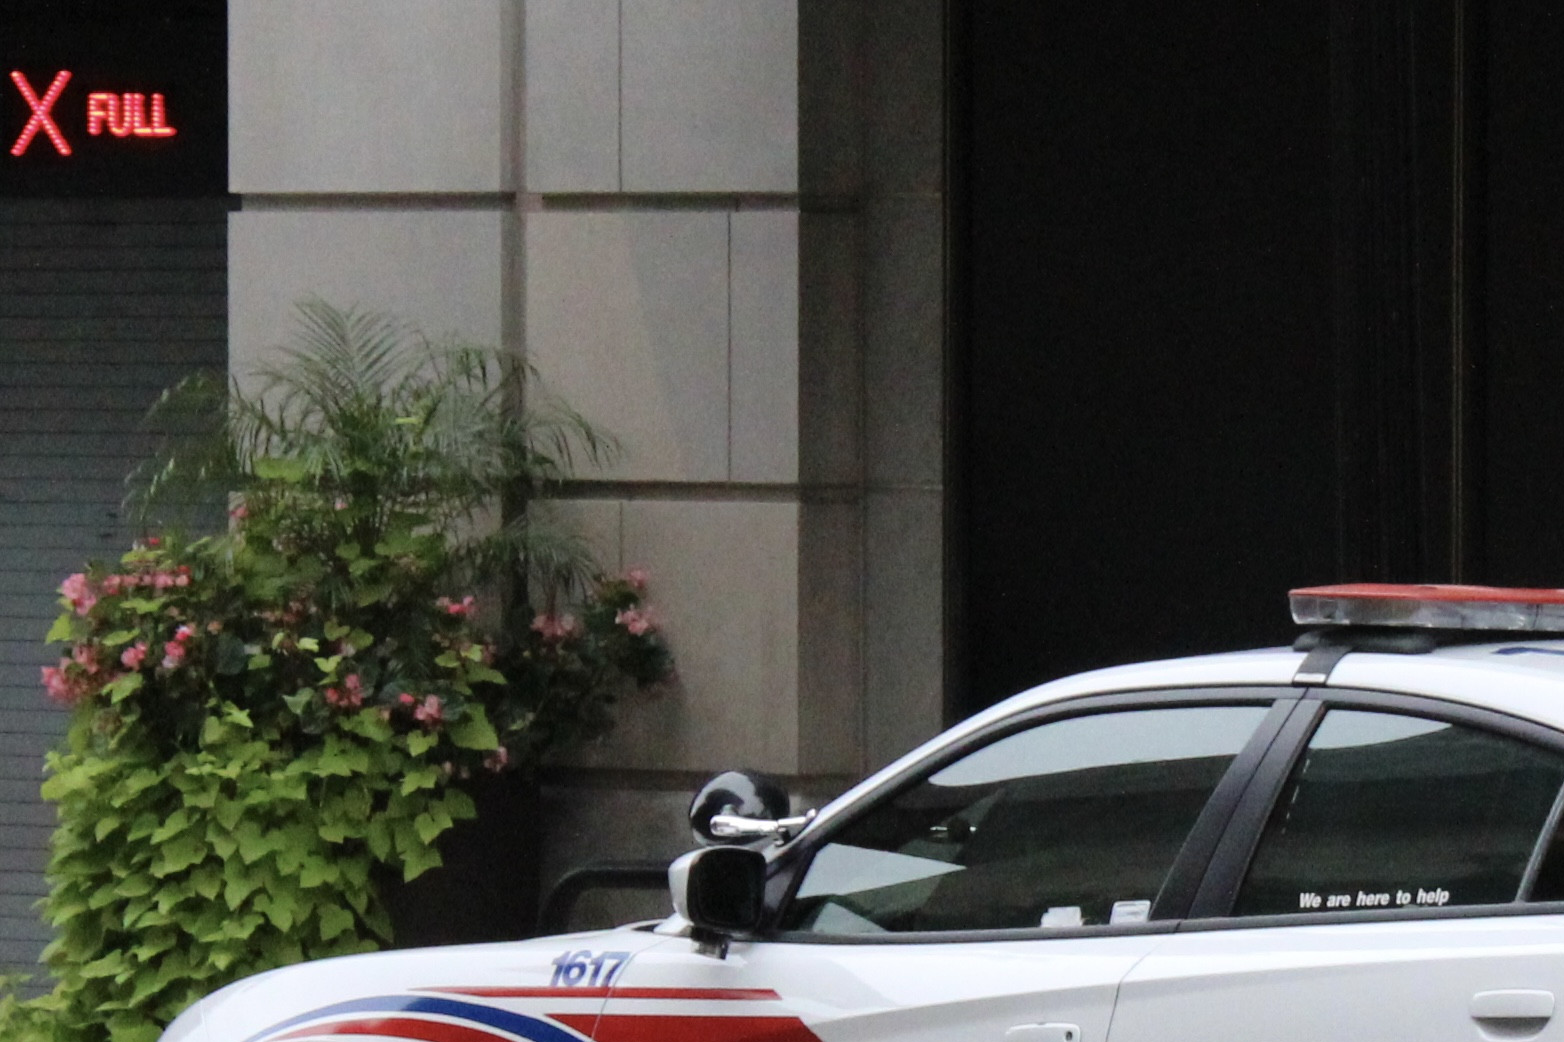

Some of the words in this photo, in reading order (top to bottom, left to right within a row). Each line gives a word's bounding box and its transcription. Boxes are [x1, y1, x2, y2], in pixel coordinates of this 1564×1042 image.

[87, 93, 177, 136] FULL
[1299, 892, 1322, 908] We
[1326, 894, 1351, 907] are
[1356, 890, 1390, 906] here
[1396, 889, 1412, 905] to
[1416, 887, 1450, 906] help
[550, 949, 631, 987] 1617
